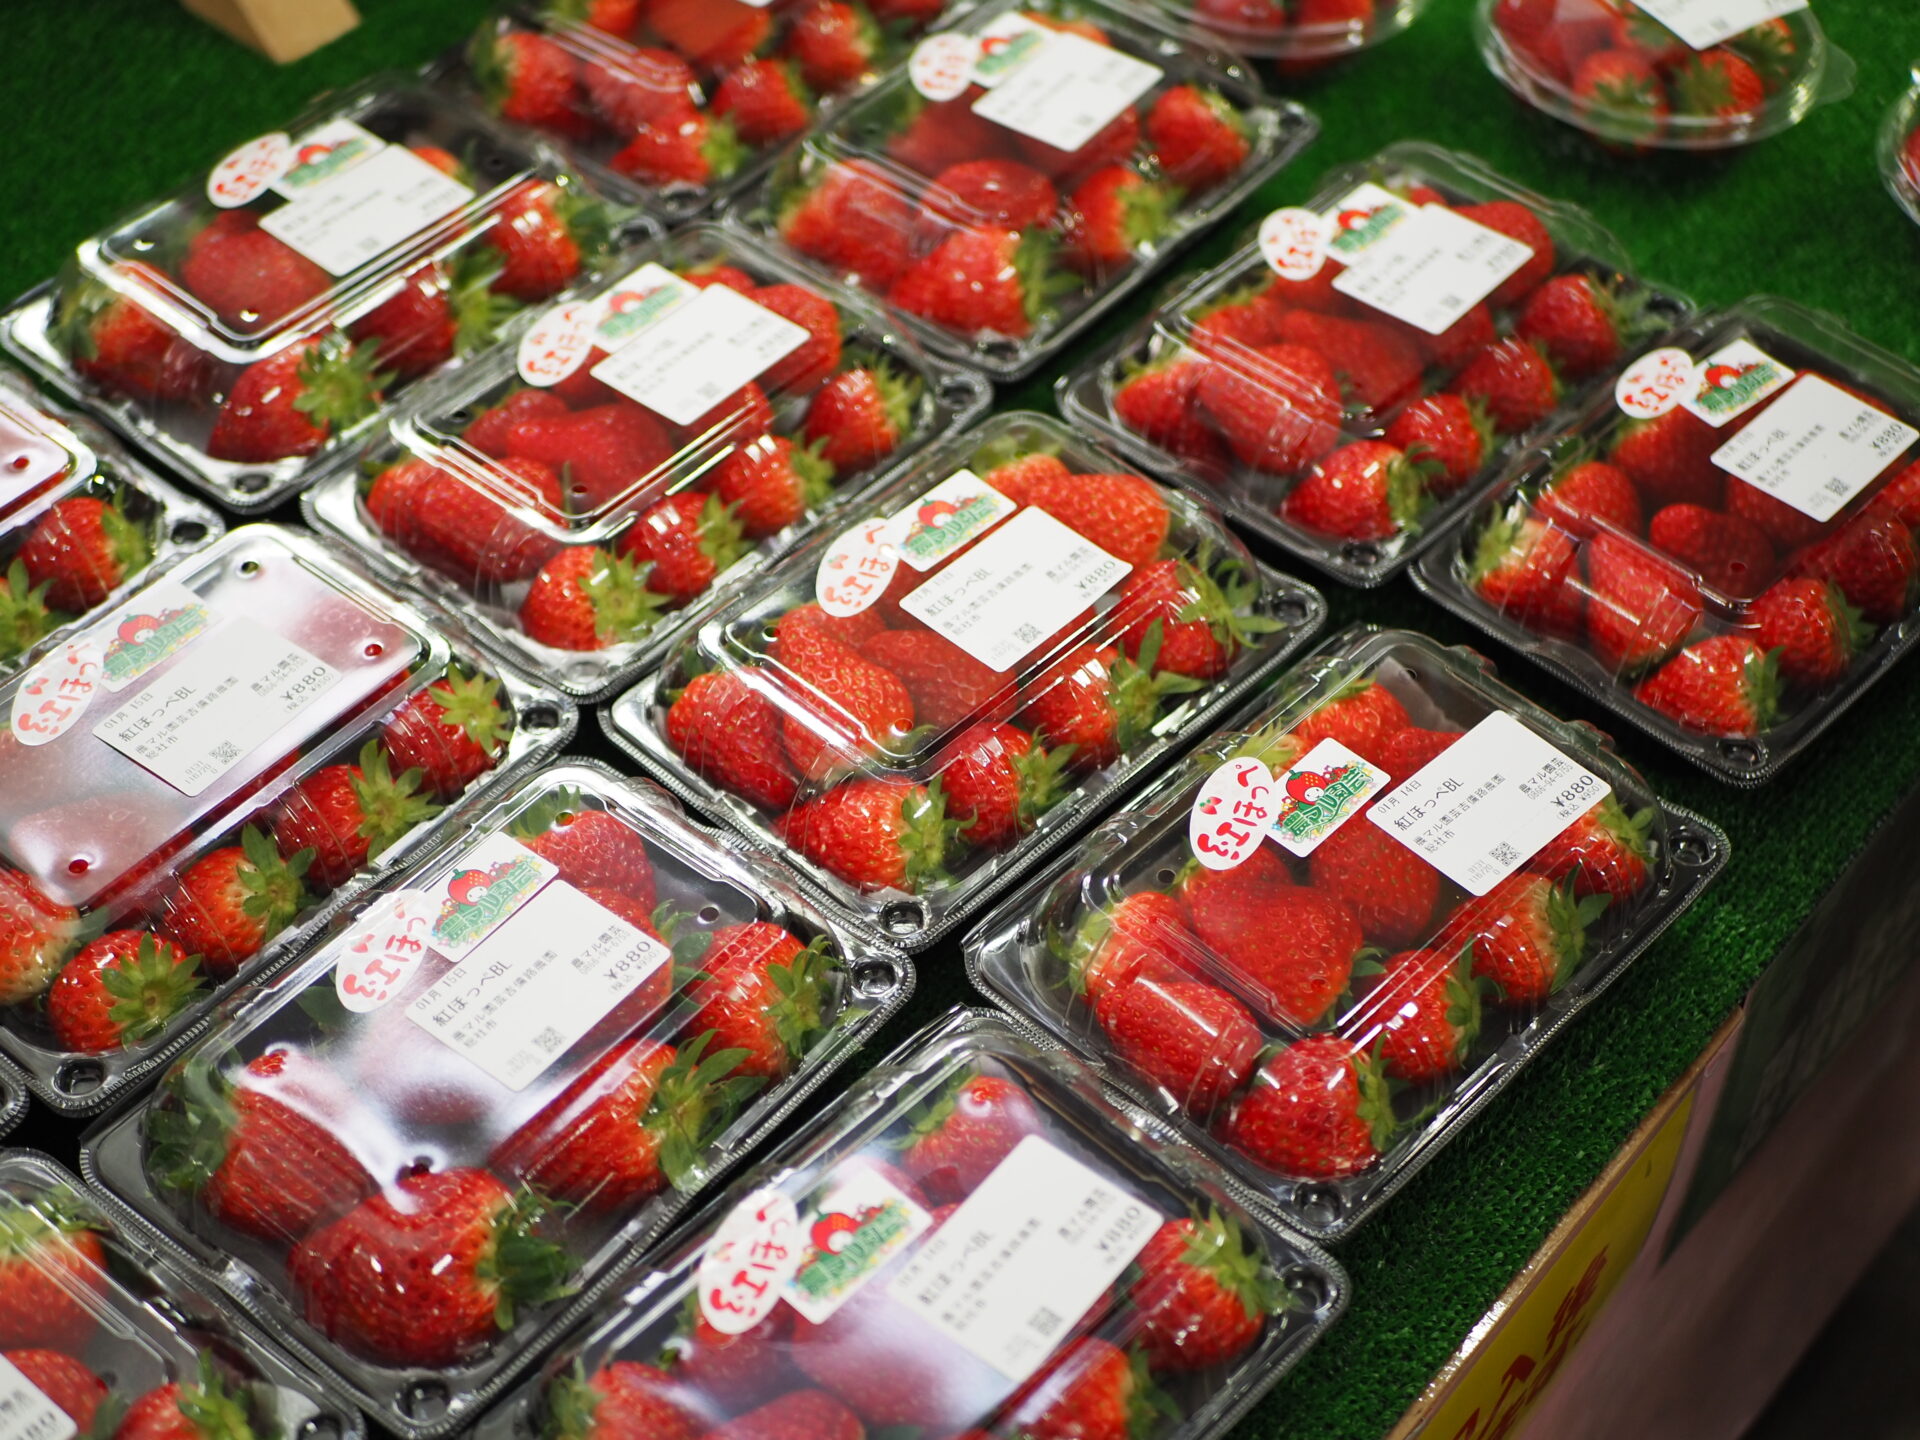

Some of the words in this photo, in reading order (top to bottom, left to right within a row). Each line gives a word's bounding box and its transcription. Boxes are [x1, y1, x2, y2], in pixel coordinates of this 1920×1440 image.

[1074, 560, 1116, 589] ¥880
[279, 665, 326, 700] ¥880
[118, 686, 196, 742] 紅ほっぺBL
[1518, 756, 1564, 794] 農マル園芸
[1550, 774, 1593, 807] ¥880
[1197, 764, 1269, 860] 紅ほっぺ
[1282, 767, 1374, 840] 農マル園芸
[1376, 796, 1400, 814] 01月
[1399, 779, 1422, 796] 14日
[1393, 777, 1464, 830] 紅ほっぺBL
[1423, 828, 1455, 853] 総社市
[603, 940, 651, 979] ¥880
[432, 960, 512, 1026] 紅ほっぺBL
